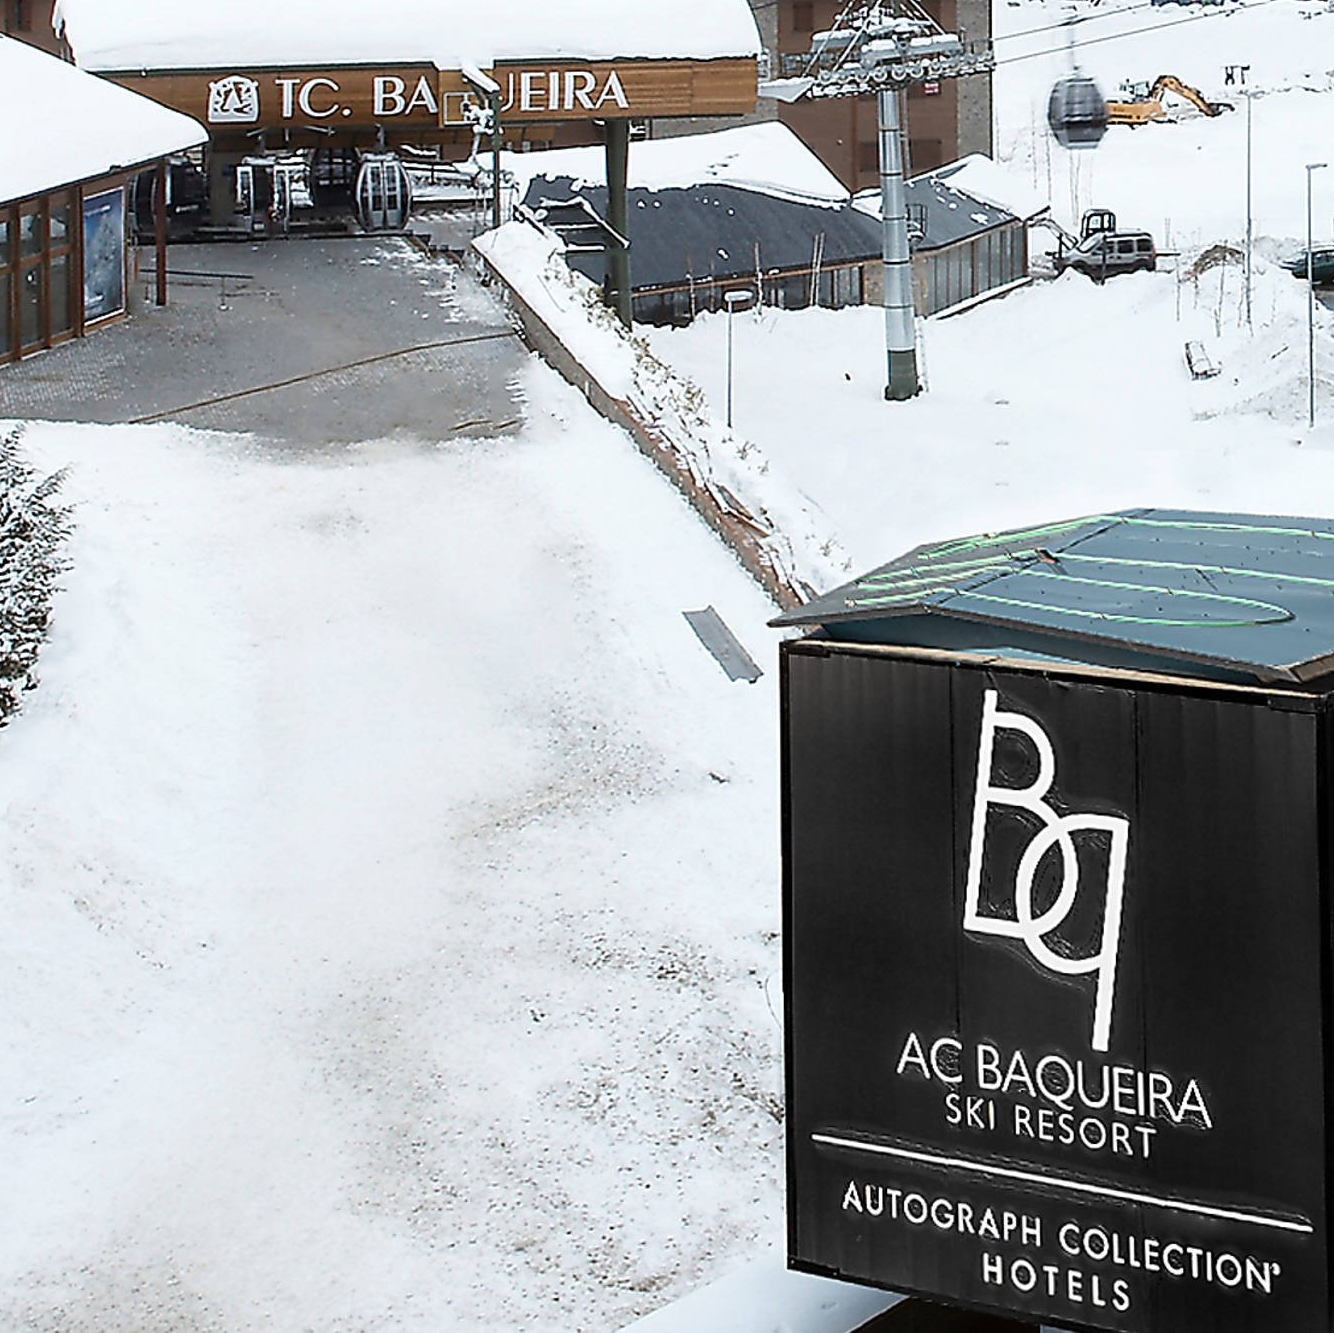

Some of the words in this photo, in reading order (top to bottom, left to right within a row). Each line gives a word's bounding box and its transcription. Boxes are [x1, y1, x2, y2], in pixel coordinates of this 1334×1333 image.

[275, 78, 351, 117] TC.
[374, 71, 629, 116] BAEIRA
[897, 1032, 963, 1083] AC
[977, 1044, 1213, 1128] BAQUEIRA
[945, 1093, 995, 1130] SKI
[1015, 1105, 1157, 1158] RESORT
[842, 1180, 1041, 1247] AUTOGRAPH
[982, 1253, 1130, 1311] HOTELS
